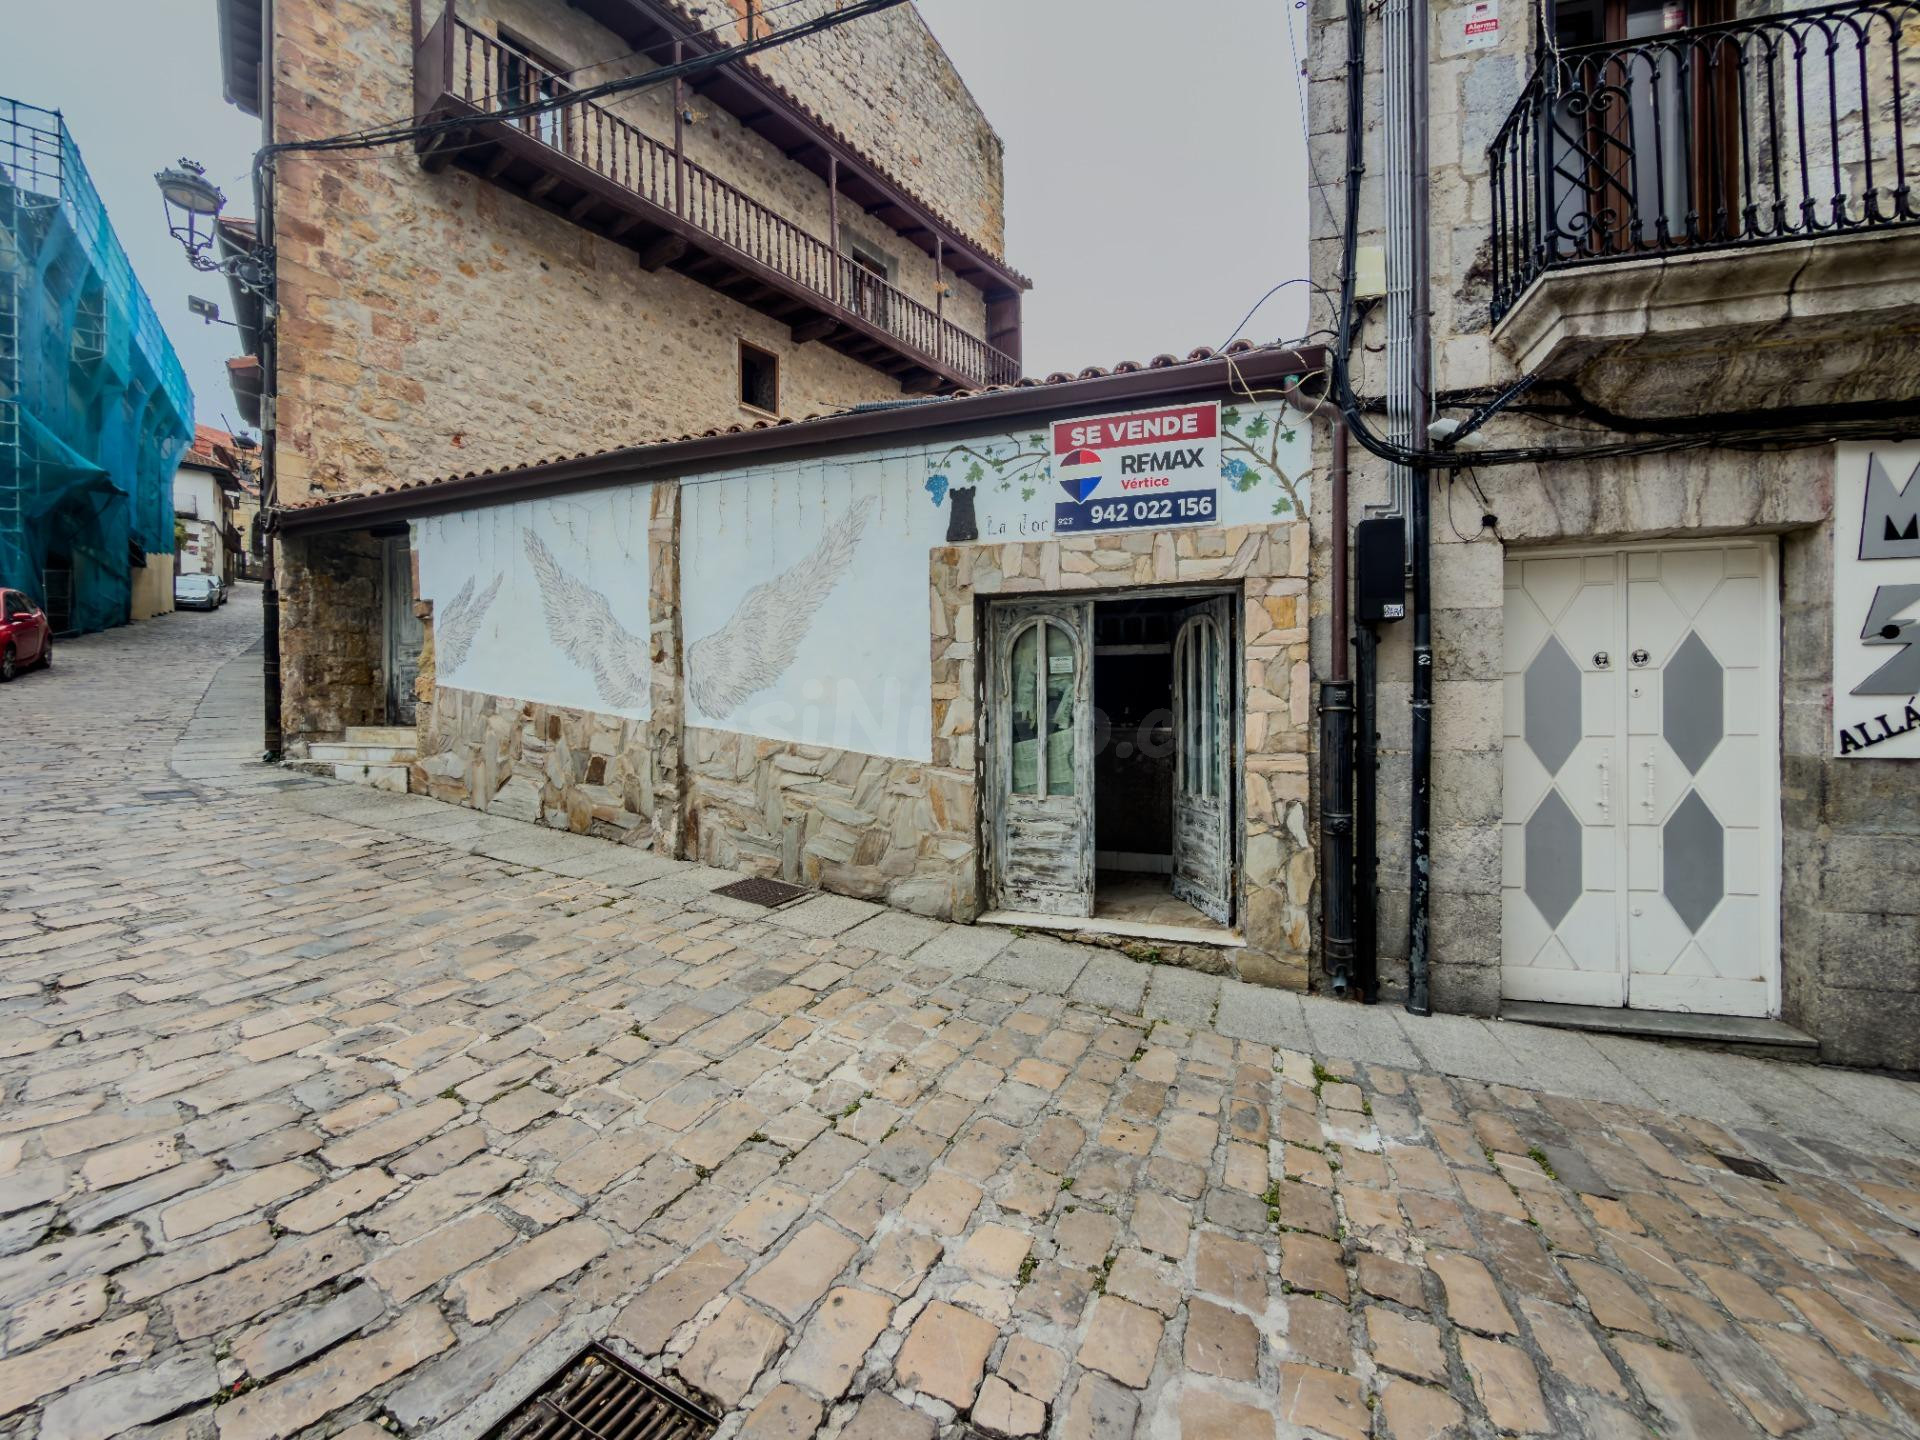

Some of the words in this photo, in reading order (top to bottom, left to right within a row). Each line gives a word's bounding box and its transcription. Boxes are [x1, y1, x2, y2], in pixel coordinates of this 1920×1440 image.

[1071, 426, 1101, 446] SE
[1108, 413, 1198, 442] VENDE
[1121, 476, 1169, 490] Vértice
[1091, 505, 1128, 523] 942
[1134, 500, 1172, 519] 022
[1178, 496, 1212, 517] 156
